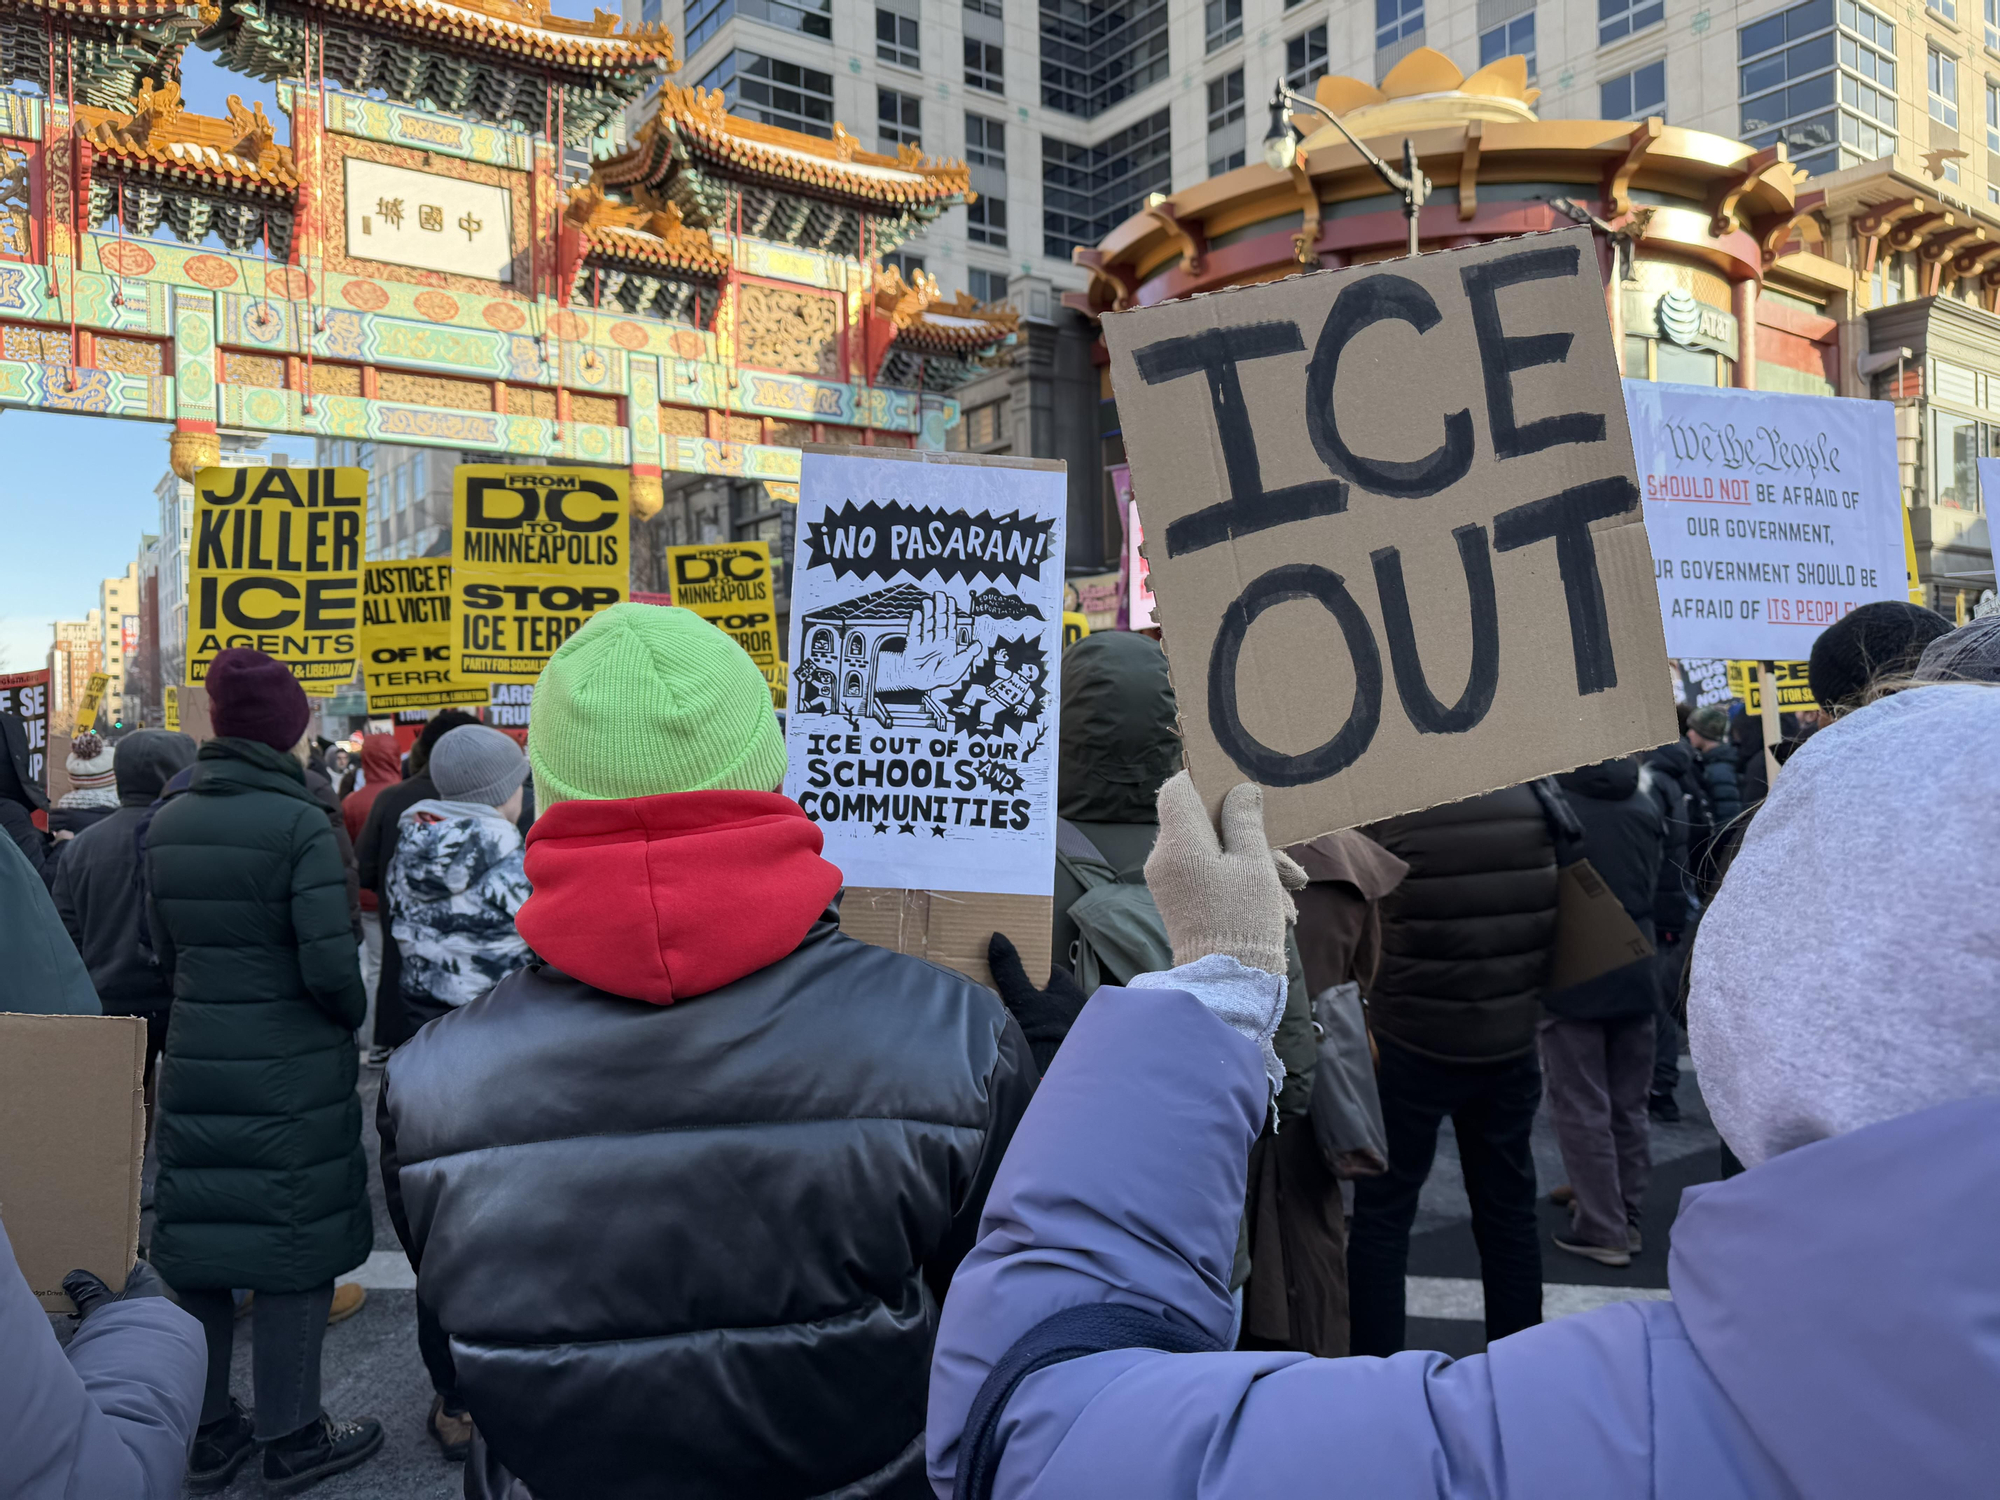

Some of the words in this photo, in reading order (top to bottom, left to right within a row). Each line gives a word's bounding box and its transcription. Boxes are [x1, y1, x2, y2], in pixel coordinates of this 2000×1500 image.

[1699, 309, 1732, 343] AT&T
[1132, 245, 1607, 558] ICE
[1664, 417, 1714, 466] We
[1755, 425, 1841, 483] People
[202, 468, 361, 507] JAIL
[508, 475, 576, 488] FROM
[1647, 474, 1714, 499] SHOULD
[1720, 478, 1750, 501] NOT
[1756, 484, 1776, 503] BE
[1783, 486, 1838, 508] AFRAID
[1842, 491, 1859, 510] OF
[466, 477, 619, 533] DC
[198, 509, 359, 572] KILLER
[526, 523, 558, 534] TO
[820, 525, 876, 559] ¡NO
[891, 516, 1046, 566] PASARÁN!
[1687, 517, 1720, 538] OUR
[1726, 518, 1835, 545] GOVERNMENT,
[464, 530, 618, 565] MINNEAPOLIS
[675, 551, 764, 585] DC
[1681, 560, 1790, 584] GOVERNMENT
[1797, 562, 1855, 587] SHOULD
[1861, 568, 1878, 588] BE
[200, 577, 358, 630] ICE
[463, 584, 620, 611] STOP
[677, 582, 767, 605] MINNEAPOLIS
[1671, 598, 1733, 619] AFRAID
[1740, 600, 1760, 620] OF
[1767, 598, 1790, 620] ITS
[363, 597, 396, 626] ALL
[197, 634, 355, 655] AGENTS
[463, 614, 506, 651] ICE
[513, 616, 593, 652] TERR
[1207, 476, 1641, 787] OUT
[293, 665, 305, 678] &
[306, 662, 352, 679] LIBERATION
[371, 648, 417, 664] OF
[464, 657, 492, 671] PARTY
[493, 658, 510, 672] FOR
[19, 685, 45, 717] SE
[490, 705, 531, 725] TRU
[807, 734, 861, 756] ICE
[870, 736, 921, 755] OUT
[929, 739, 958, 758] OF
[968, 741, 1019, 760] OUR
[806, 758, 977, 791] SCHOOLS
[979, 761, 1015, 789] AND
[799, 790, 1032, 831] COMMUNITIES
